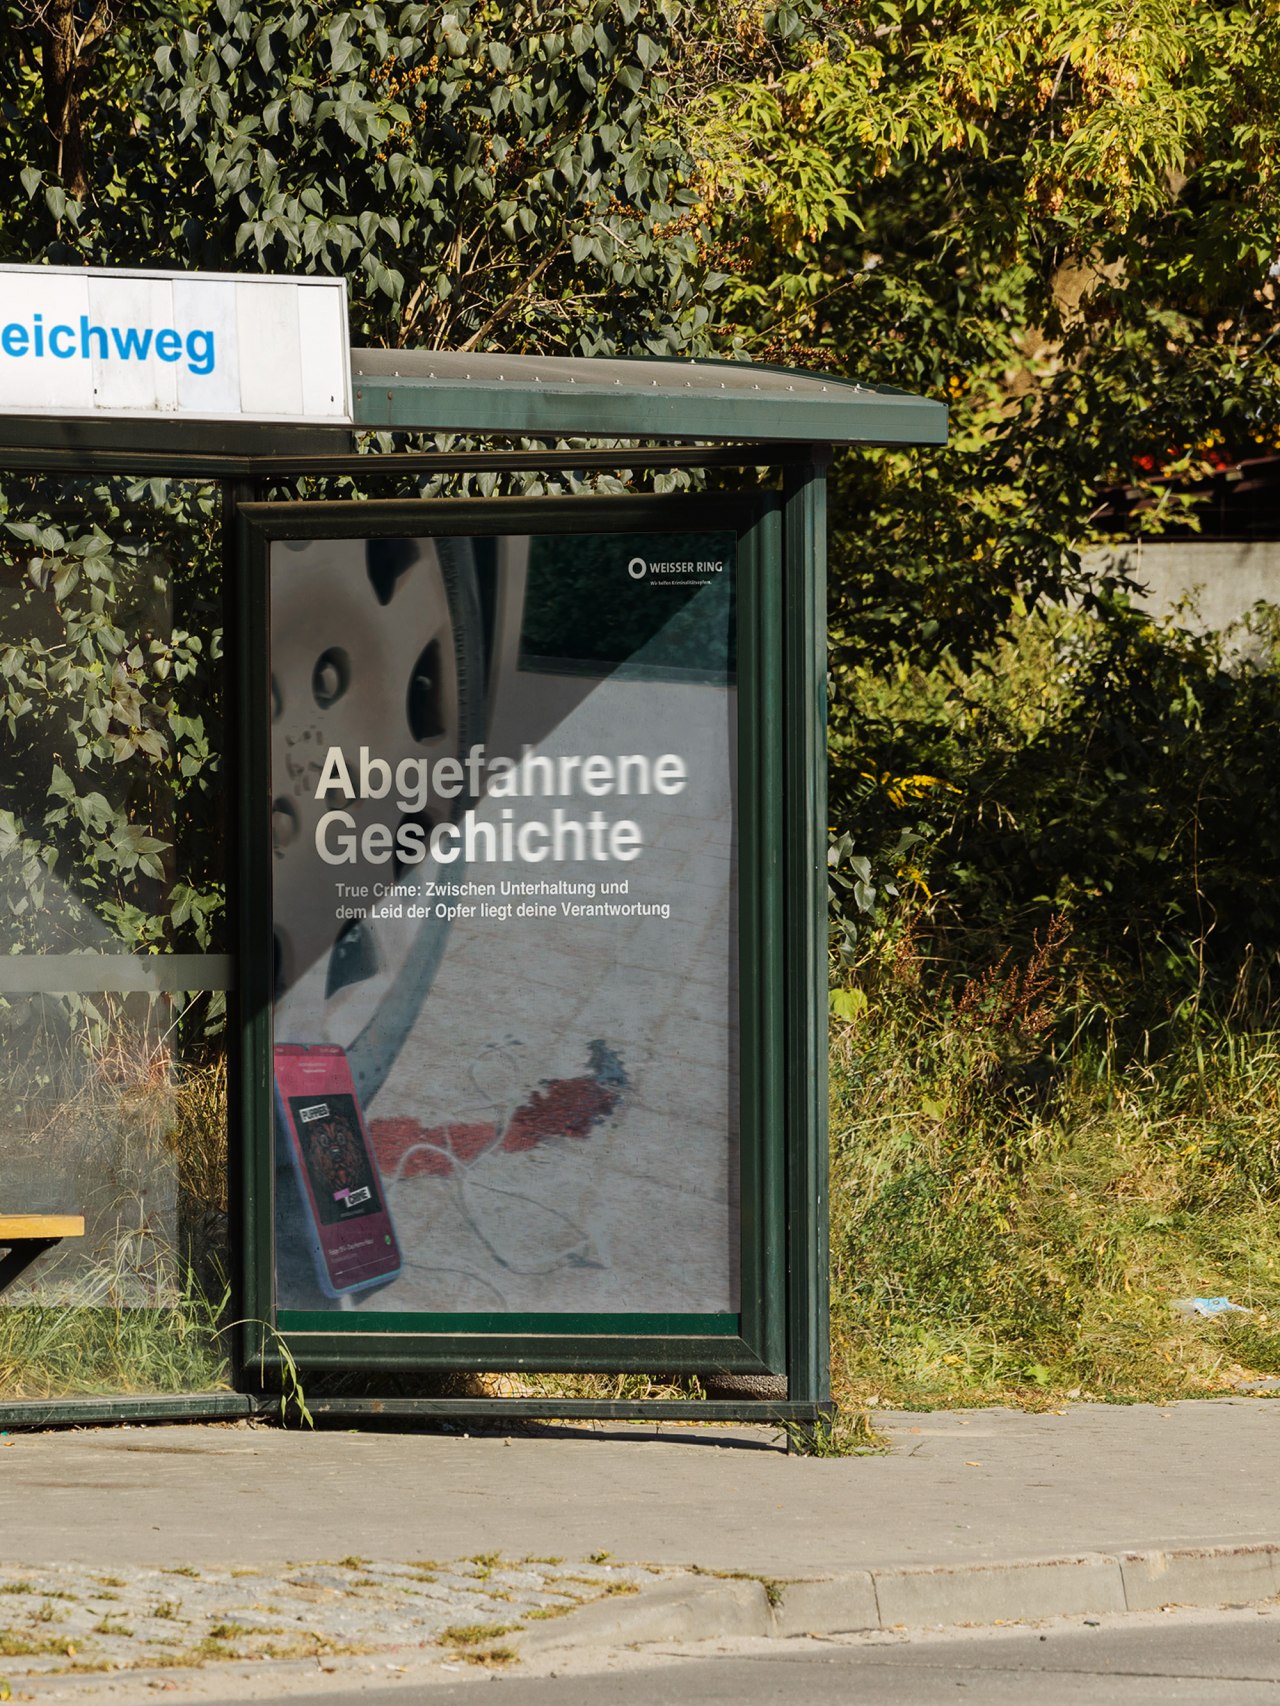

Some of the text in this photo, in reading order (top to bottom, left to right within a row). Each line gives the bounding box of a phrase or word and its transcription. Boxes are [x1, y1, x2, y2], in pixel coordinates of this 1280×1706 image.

[649, 561, 723, 573] WEISSER RING
[314, 744, 687, 813] Abgefahrene
[315, 808, 642, 865] Geschichte
[336, 879, 629, 899] True Crime: Zwischen Unterhaltung und
[336, 901, 670, 922] dem Leid der Opfer liegt deine Verantwortung
